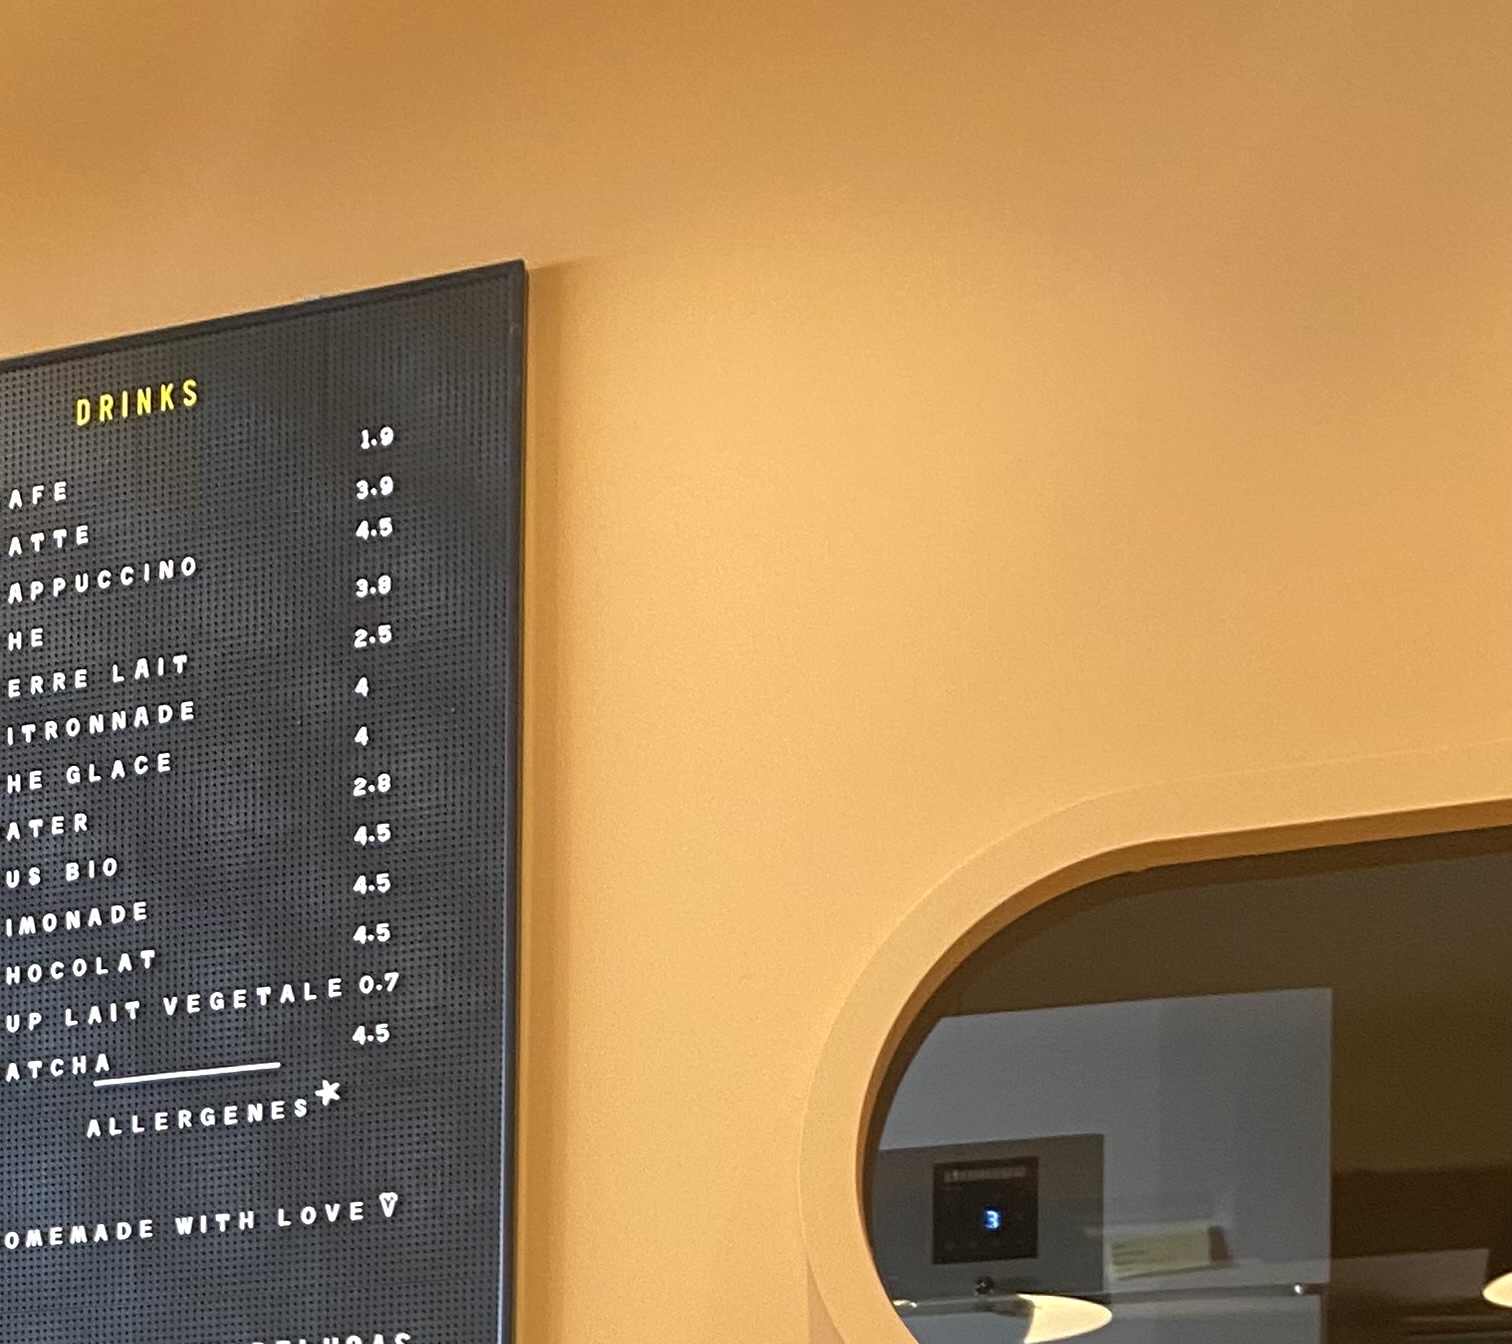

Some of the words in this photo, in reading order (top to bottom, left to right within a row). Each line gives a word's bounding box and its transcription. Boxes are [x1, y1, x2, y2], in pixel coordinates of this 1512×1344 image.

[76, 379, 197, 426] DRINKS
[360, 426, 394, 450] 1.9
[356, 476, 394, 500] 3.9
[355, 517, 393, 540] 4.5
[355, 575, 391, 598] 3.8
[112, 654, 188, 683] LAIT
[354, 624, 392, 649] 2.5
[354, 677, 369, 697] 4
[66, 752, 171, 785] GLACE
[354, 726, 369, 746] 4
[352, 773, 391, 797] 2.8
[65, 857, 117, 882] BIO
[353, 823, 391, 846] 4.5
[352, 873, 391, 895] 4.5
[353, 922, 391, 945] 4.5
[65, 1000, 140, 1027] LAIT
[163, 977, 342, 1016] VEGETALE
[359, 971, 399, 995] 0.7
[352, 1023, 390, 1046] 4.5
[86, 1098, 307, 1139] ALLERGENES
[175, 1210, 254, 1235] WITH
[277, 1201, 364, 1227] LOVE
